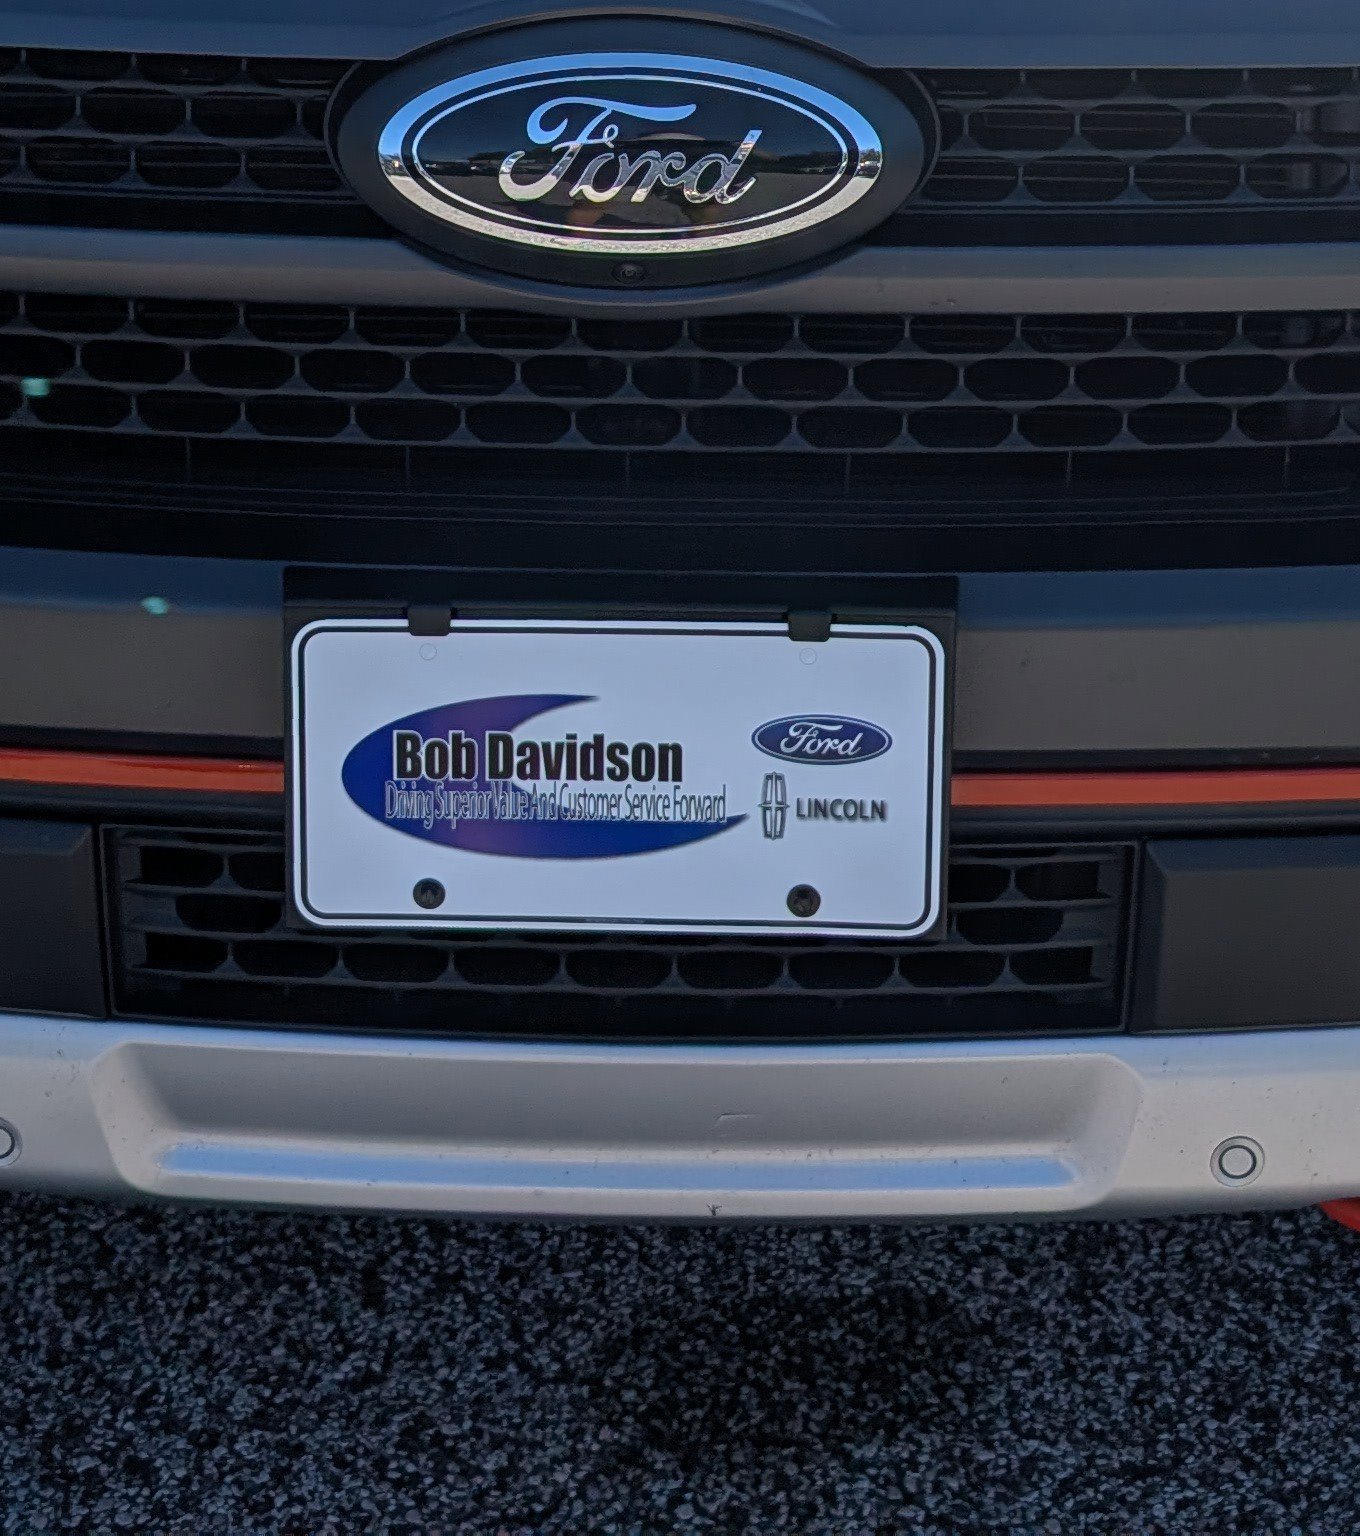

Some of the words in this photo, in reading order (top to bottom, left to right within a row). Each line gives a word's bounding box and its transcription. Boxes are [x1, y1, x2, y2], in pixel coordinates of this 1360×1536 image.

[498, 96, 762, 205] Ford
[394, 730, 478, 781] Bob
[486, 731, 683, 782] Davidson
[780, 722, 863, 755] Ford
[385, 780, 434, 829] Driving
[435, 780, 491, 829] Superior
[491, 780, 529, 820] Value
[529, 781, 558, 820] And
[559, 782, 622, 820] Customer
[624, 783, 670, 821] Service
[672, 784, 727, 822] Forward
[796, 797, 889, 823] LINCOLN
